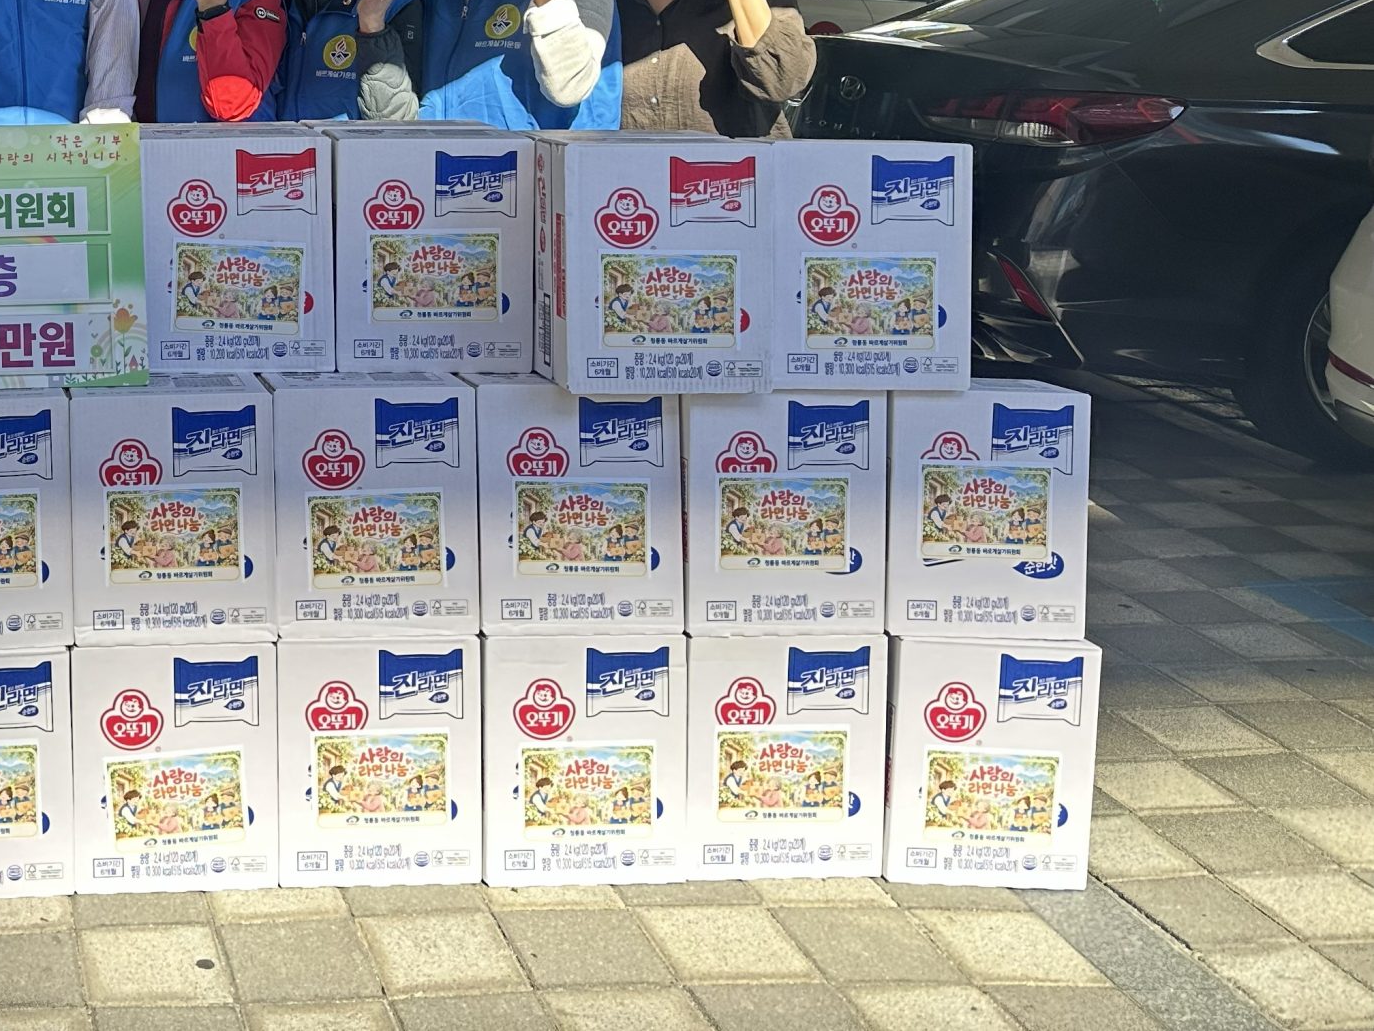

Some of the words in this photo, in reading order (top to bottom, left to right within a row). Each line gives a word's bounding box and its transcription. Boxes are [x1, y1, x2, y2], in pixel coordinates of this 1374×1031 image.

[250, 170, 303, 195] 진라면
[448, 171, 503, 196] 진라면
[885, 177, 940, 202] 진라면
[683, 180, 741, 206] 진라면
[179, 210, 215, 225] 오뚜기
[376, 210, 412, 225] 오뚜기
[810, 218, 849, 233] 오뚜기
[607, 221, 647, 237] 오뚜기
[217, 256, 260, 273] 사랑의
[216, 273, 240, 285] 라면
[242, 273, 265, 286] 나눔
[646, 267, 692, 284] 사랑의
[645, 284, 670, 297] 라면
[673, 284, 698, 298] 나눔
[389, 420, 445, 446] 진라면
[592, 419, 649, 445] 진라면
[800, 422, 856, 448] 진라면
[1004, 425, 1060, 451] 진라면
[186, 429, 242, 454] 진라면
[315, 462, 353, 478] 오뚜기
[520, 460, 557, 476] 오뚜기
[964, 478, 1007, 495] 사랑의
[559, 495, 604, 512] 사랑의
[963, 495, 986, 508] 라면
[988, 495, 1011, 509] 나눔
[558, 512, 582, 525] 라면
[585, 512, 610, 526] 나눔
[393, 671, 449, 696] 진라면
[600, 668, 656, 695] 진라면
[800, 667, 855, 693] 진라면
[1012, 676, 1069, 701] 진라면
[187, 679, 244, 705] 진라면
[318, 714, 357, 730] 오뚜기
[526, 711, 563, 727] 오뚜기
[727, 709, 764, 724] 오뚜기
[936, 714, 974, 730] 오뚜기
[113, 722, 151, 737] 오뚜기
[358, 747, 404, 764] 사랑의
[358, 765, 383, 777] 라면
[385, 764, 409, 777] 나눔
